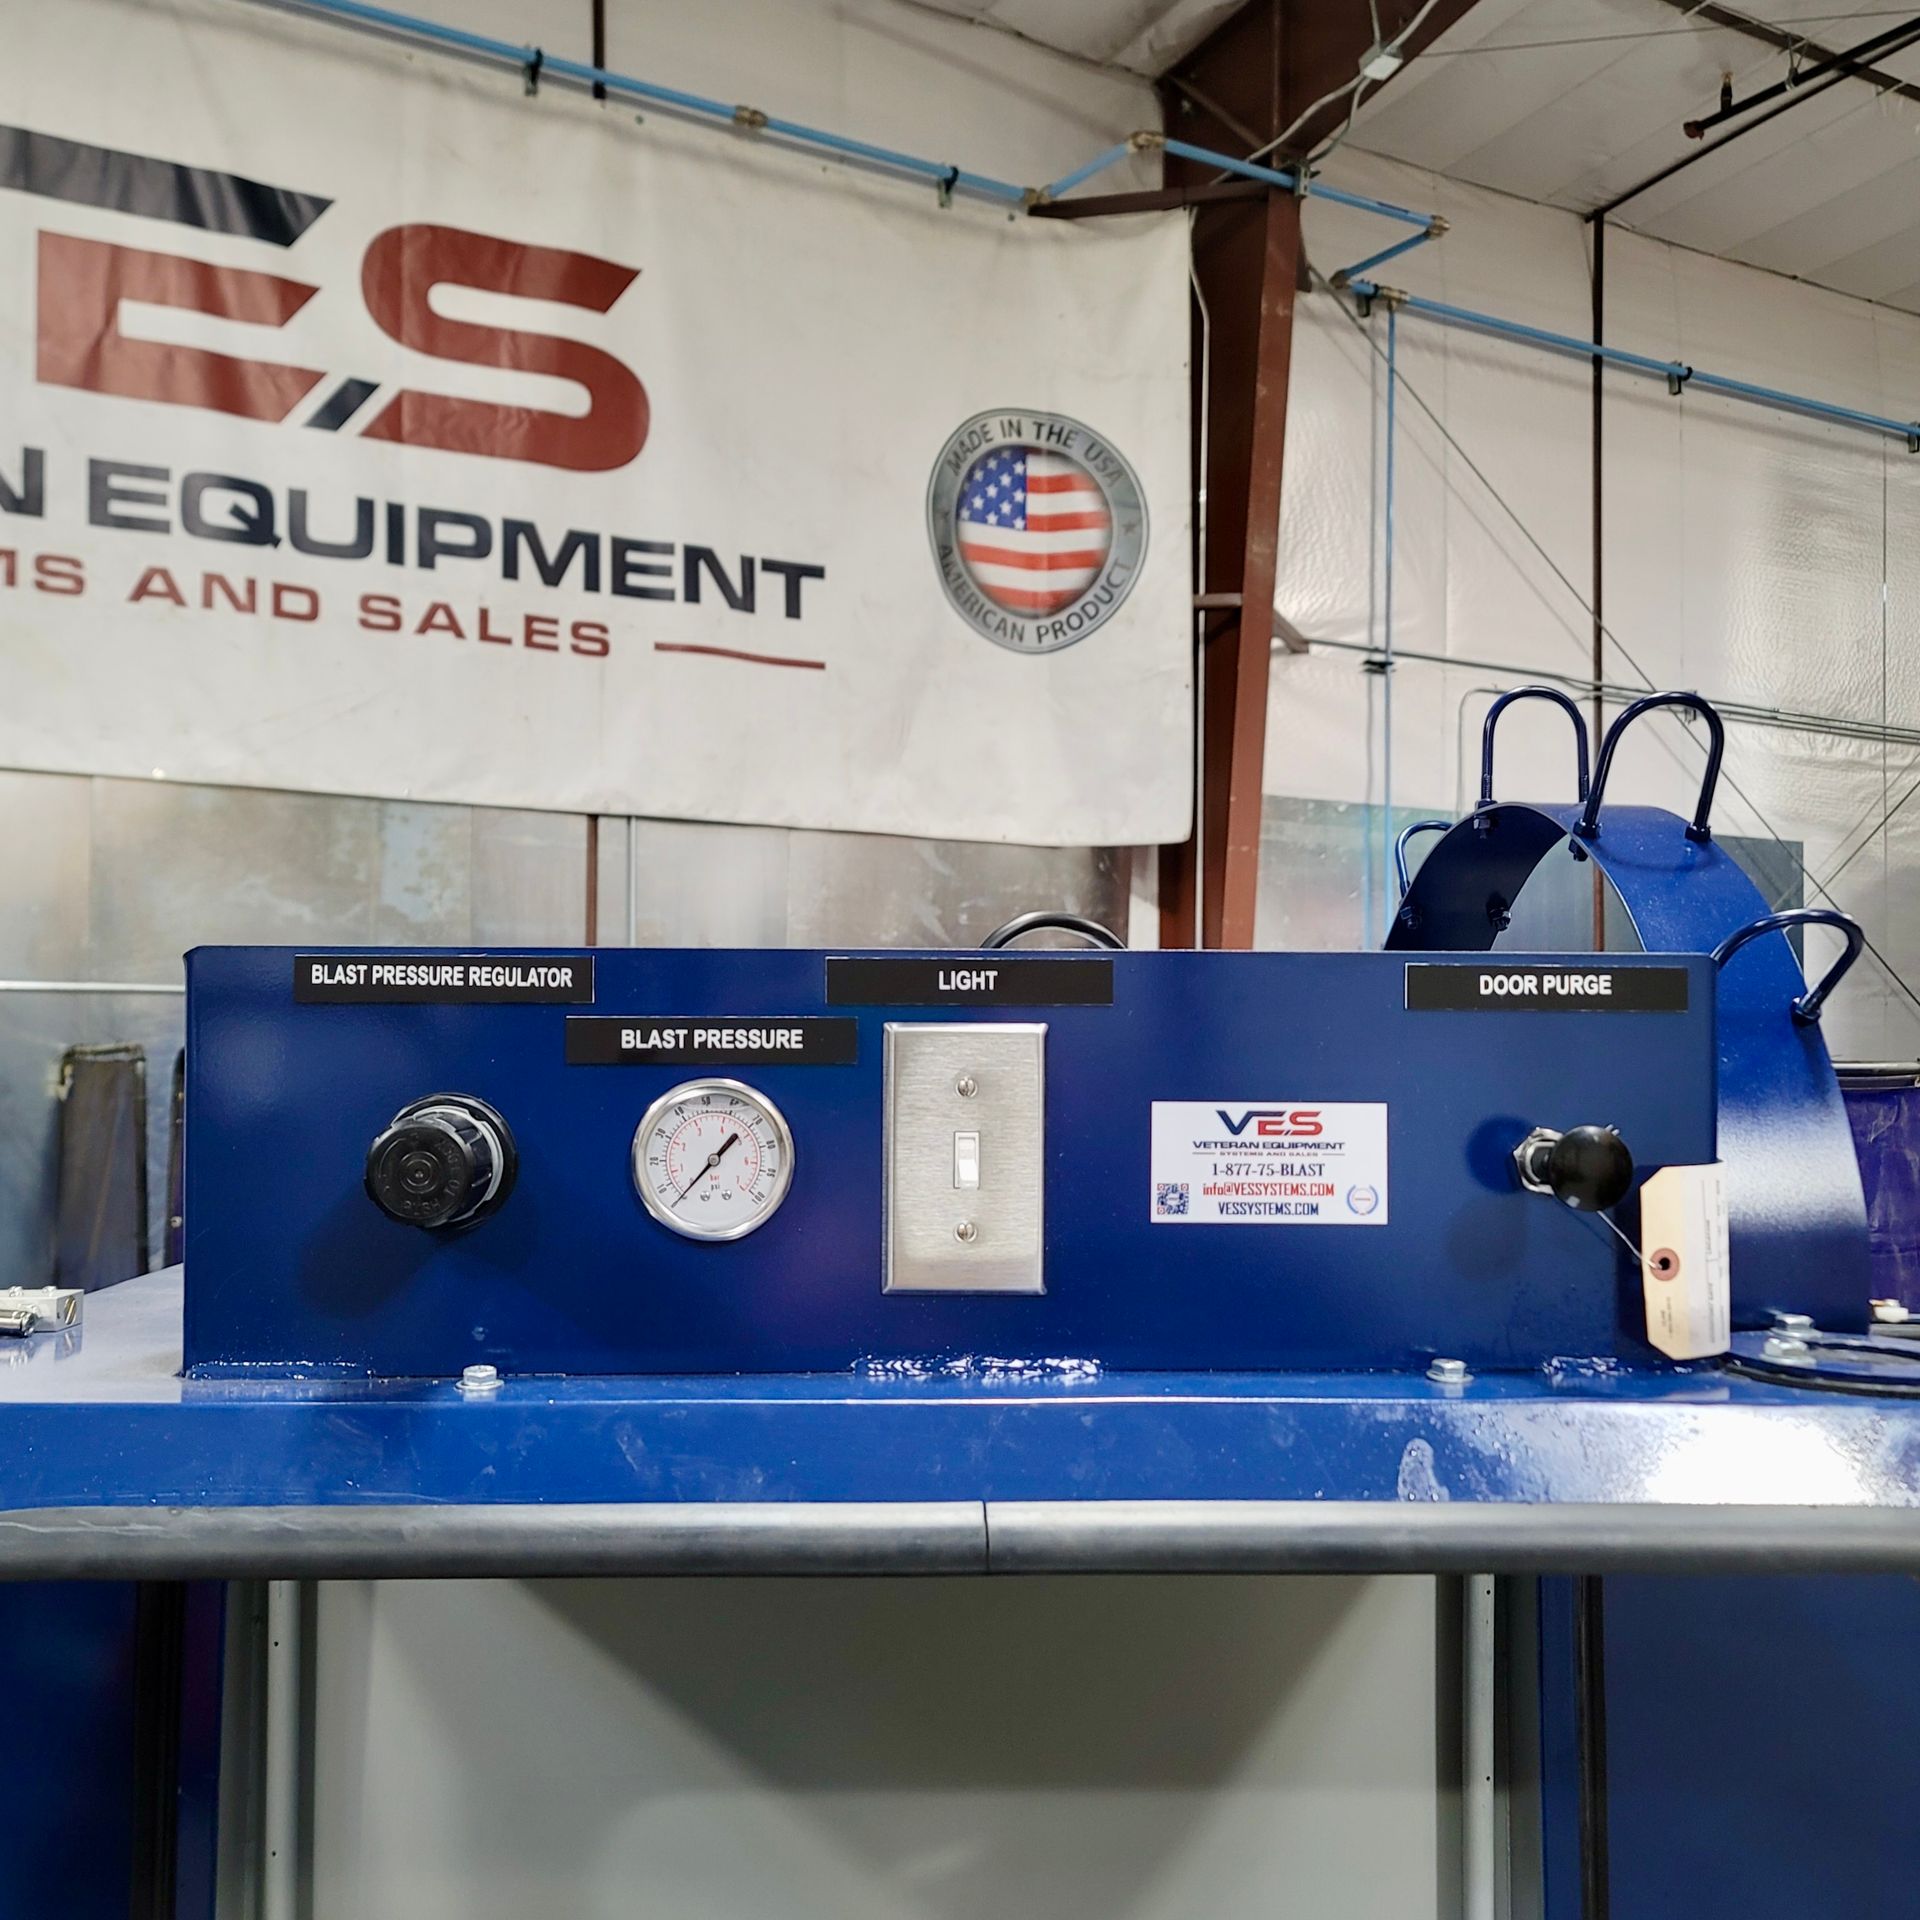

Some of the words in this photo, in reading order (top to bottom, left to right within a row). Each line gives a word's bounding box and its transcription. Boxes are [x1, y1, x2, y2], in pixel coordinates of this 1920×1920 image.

[947, 423, 994, 477] MADE
[1000, 418, 1022, 439] IN
[1033, 420, 1078, 449] THE
[1083, 442, 1126, 488] USA
[88, 457, 826, 620] EQUIPMENT
[939, 544, 1026, 643] AMERICAN
[1036, 556, 1131, 645] PRODUCT
[127, 565, 320, 623] AND
[358, 593, 611, 658] SALES
[311, 964, 368, 985] BLAST
[372, 965, 464, 987] PRESSURE
[468, 966, 573, 988] REGULATOR
[938, 969, 998, 991] LIGHT
[1479, 974, 1538, 996] DOOR
[1542, 975, 1613, 996] PURGE
[620, 1028, 688, 1049] BLAST
[693, 1029, 804, 1050] PRESSURE
[655, 1127, 666, 1139] 30
[1216, 1110, 1323, 1136] VES
[1192, 1141, 1260, 1149] VETERAN
[1262, 1141, 1345, 1150] EQUIPMENT
[1212, 1163, 1325, 1177] 1-877-75-BLAST
[751, 1191, 765, 1205] 100
[1202, 1183, 1335, 1197] info@VESSYSTEMS.COM
[1218, 1202, 1319, 1216] VESSYSTEMS.COM
